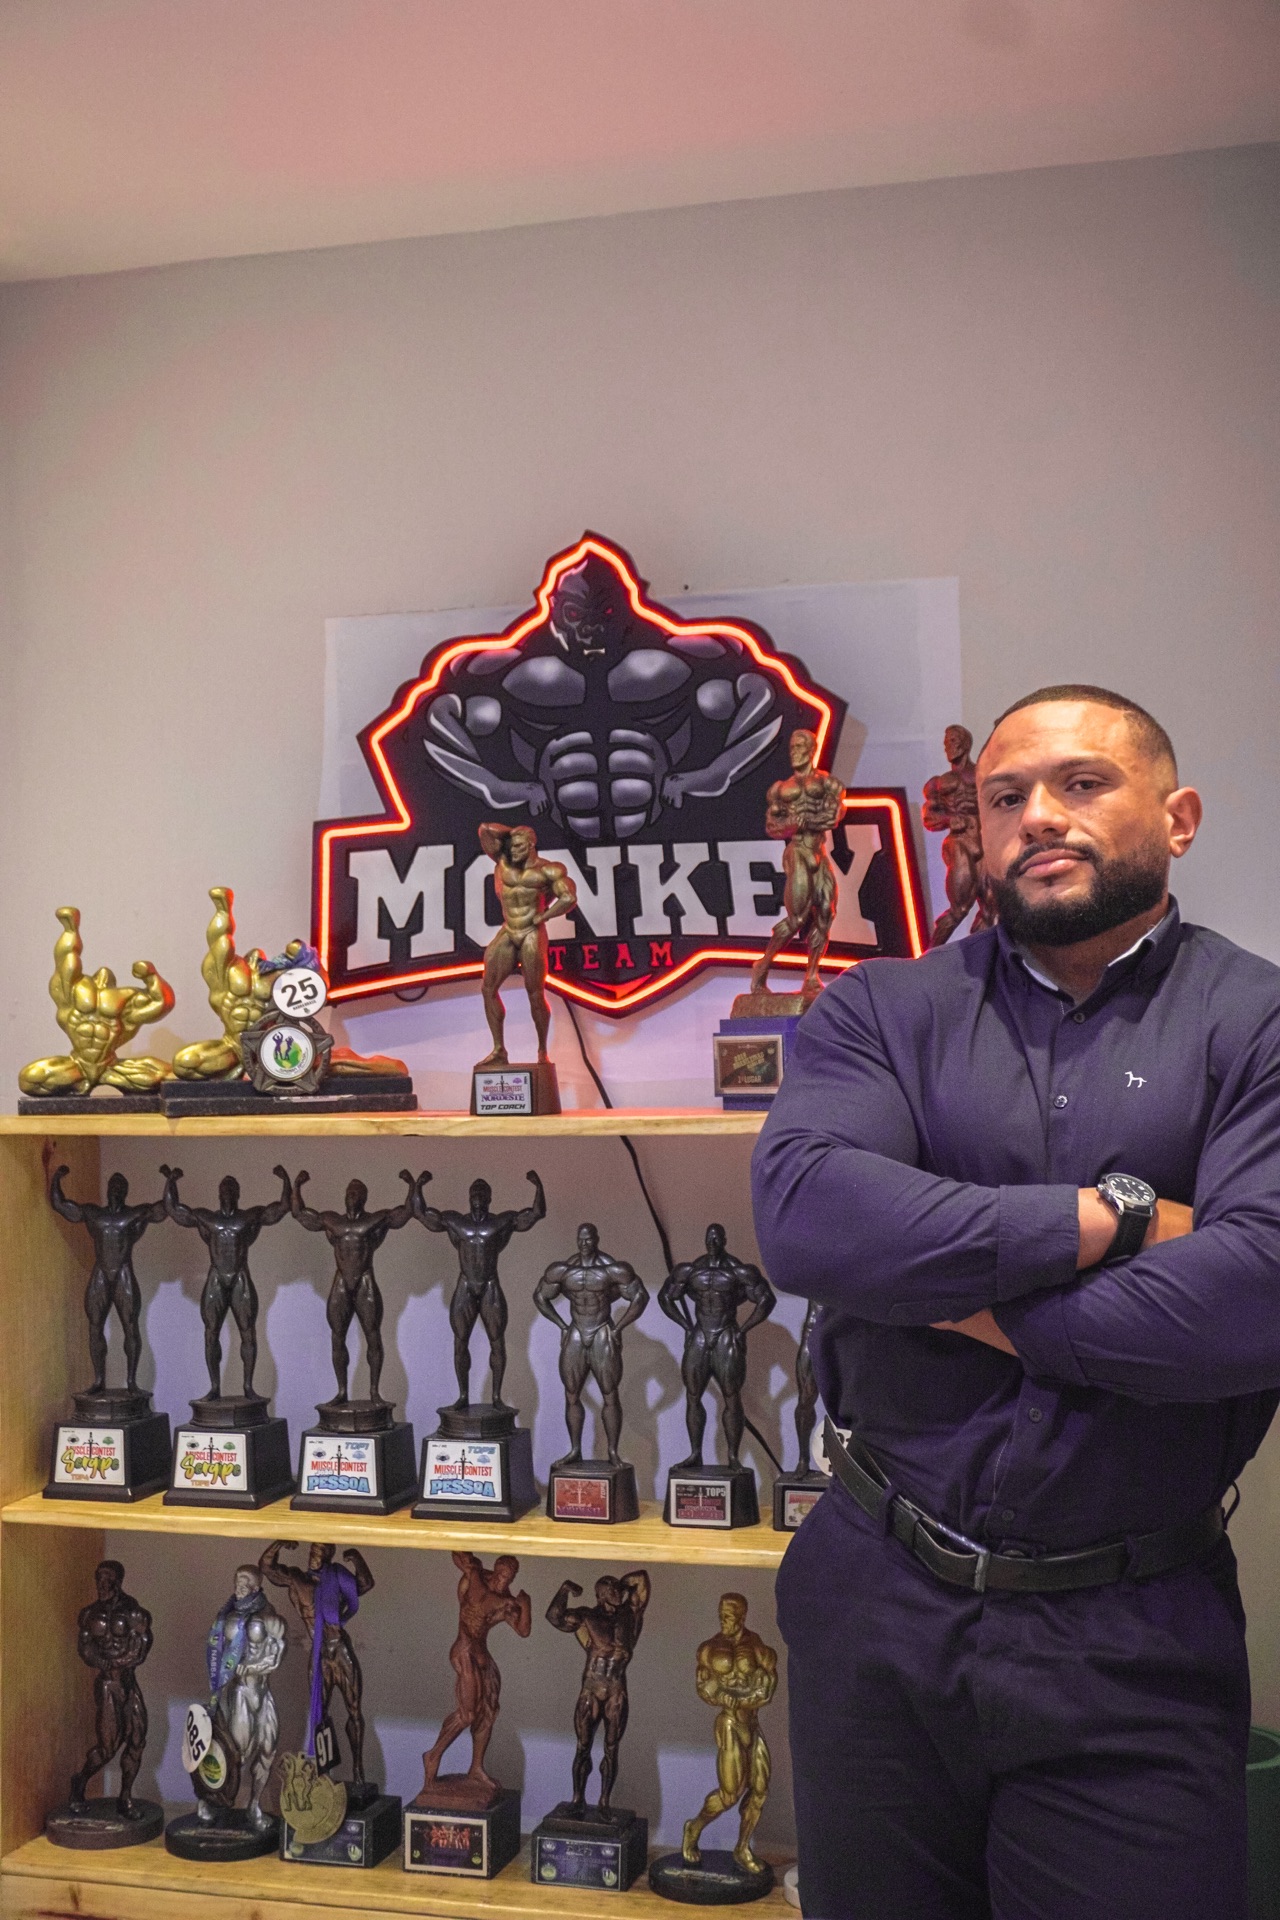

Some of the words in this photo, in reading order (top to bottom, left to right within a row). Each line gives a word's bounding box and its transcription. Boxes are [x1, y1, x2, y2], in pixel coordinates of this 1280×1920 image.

[549, 942, 673, 971] TEAM
[281, 977, 318, 1008] 25
[481, 1094, 525, 1102] NORDESTE
[91, 1447, 116, 1456] CONTEST
[212, 1452, 237, 1462] CONTEST
[311, 1461, 338, 1471] MUSCLE
[340, 1462, 367, 1472] CONTEST
[434, 1465, 462, 1475] MUSCLE
[464, 1466, 493, 1476] CONTEST
[307, 1475, 370, 1493] PESSOA
[430, 1479, 496, 1498] PESSOA
[705, 1487, 726, 1497] TOP5
[186, 1710, 207, 1762] 085
[316, 1727, 333, 1767] 97
